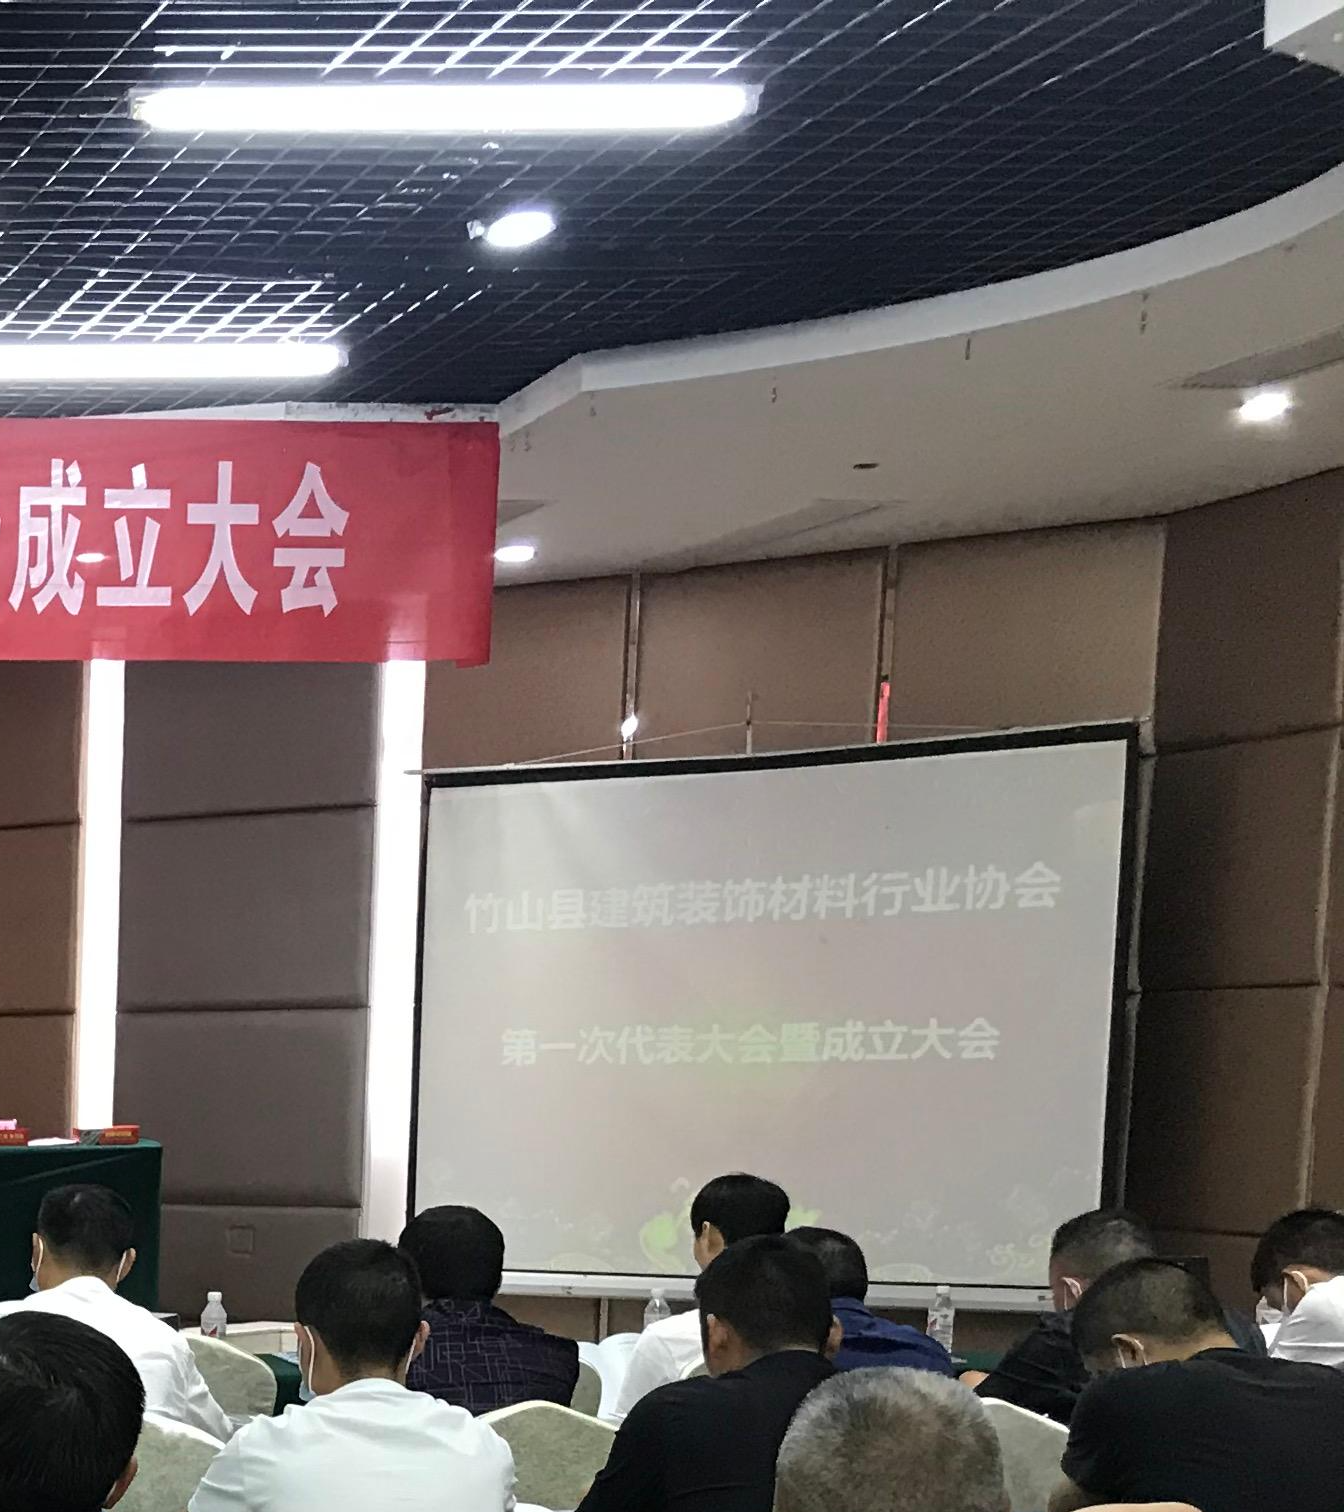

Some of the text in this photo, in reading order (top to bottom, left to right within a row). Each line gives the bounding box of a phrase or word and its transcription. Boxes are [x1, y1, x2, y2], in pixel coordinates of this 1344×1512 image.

[464, 860, 1062, 934] 竹山县建筑装饰材料行业协会
[500, 1016, 1001, 1067] 第一次代表大会暨成立大会
